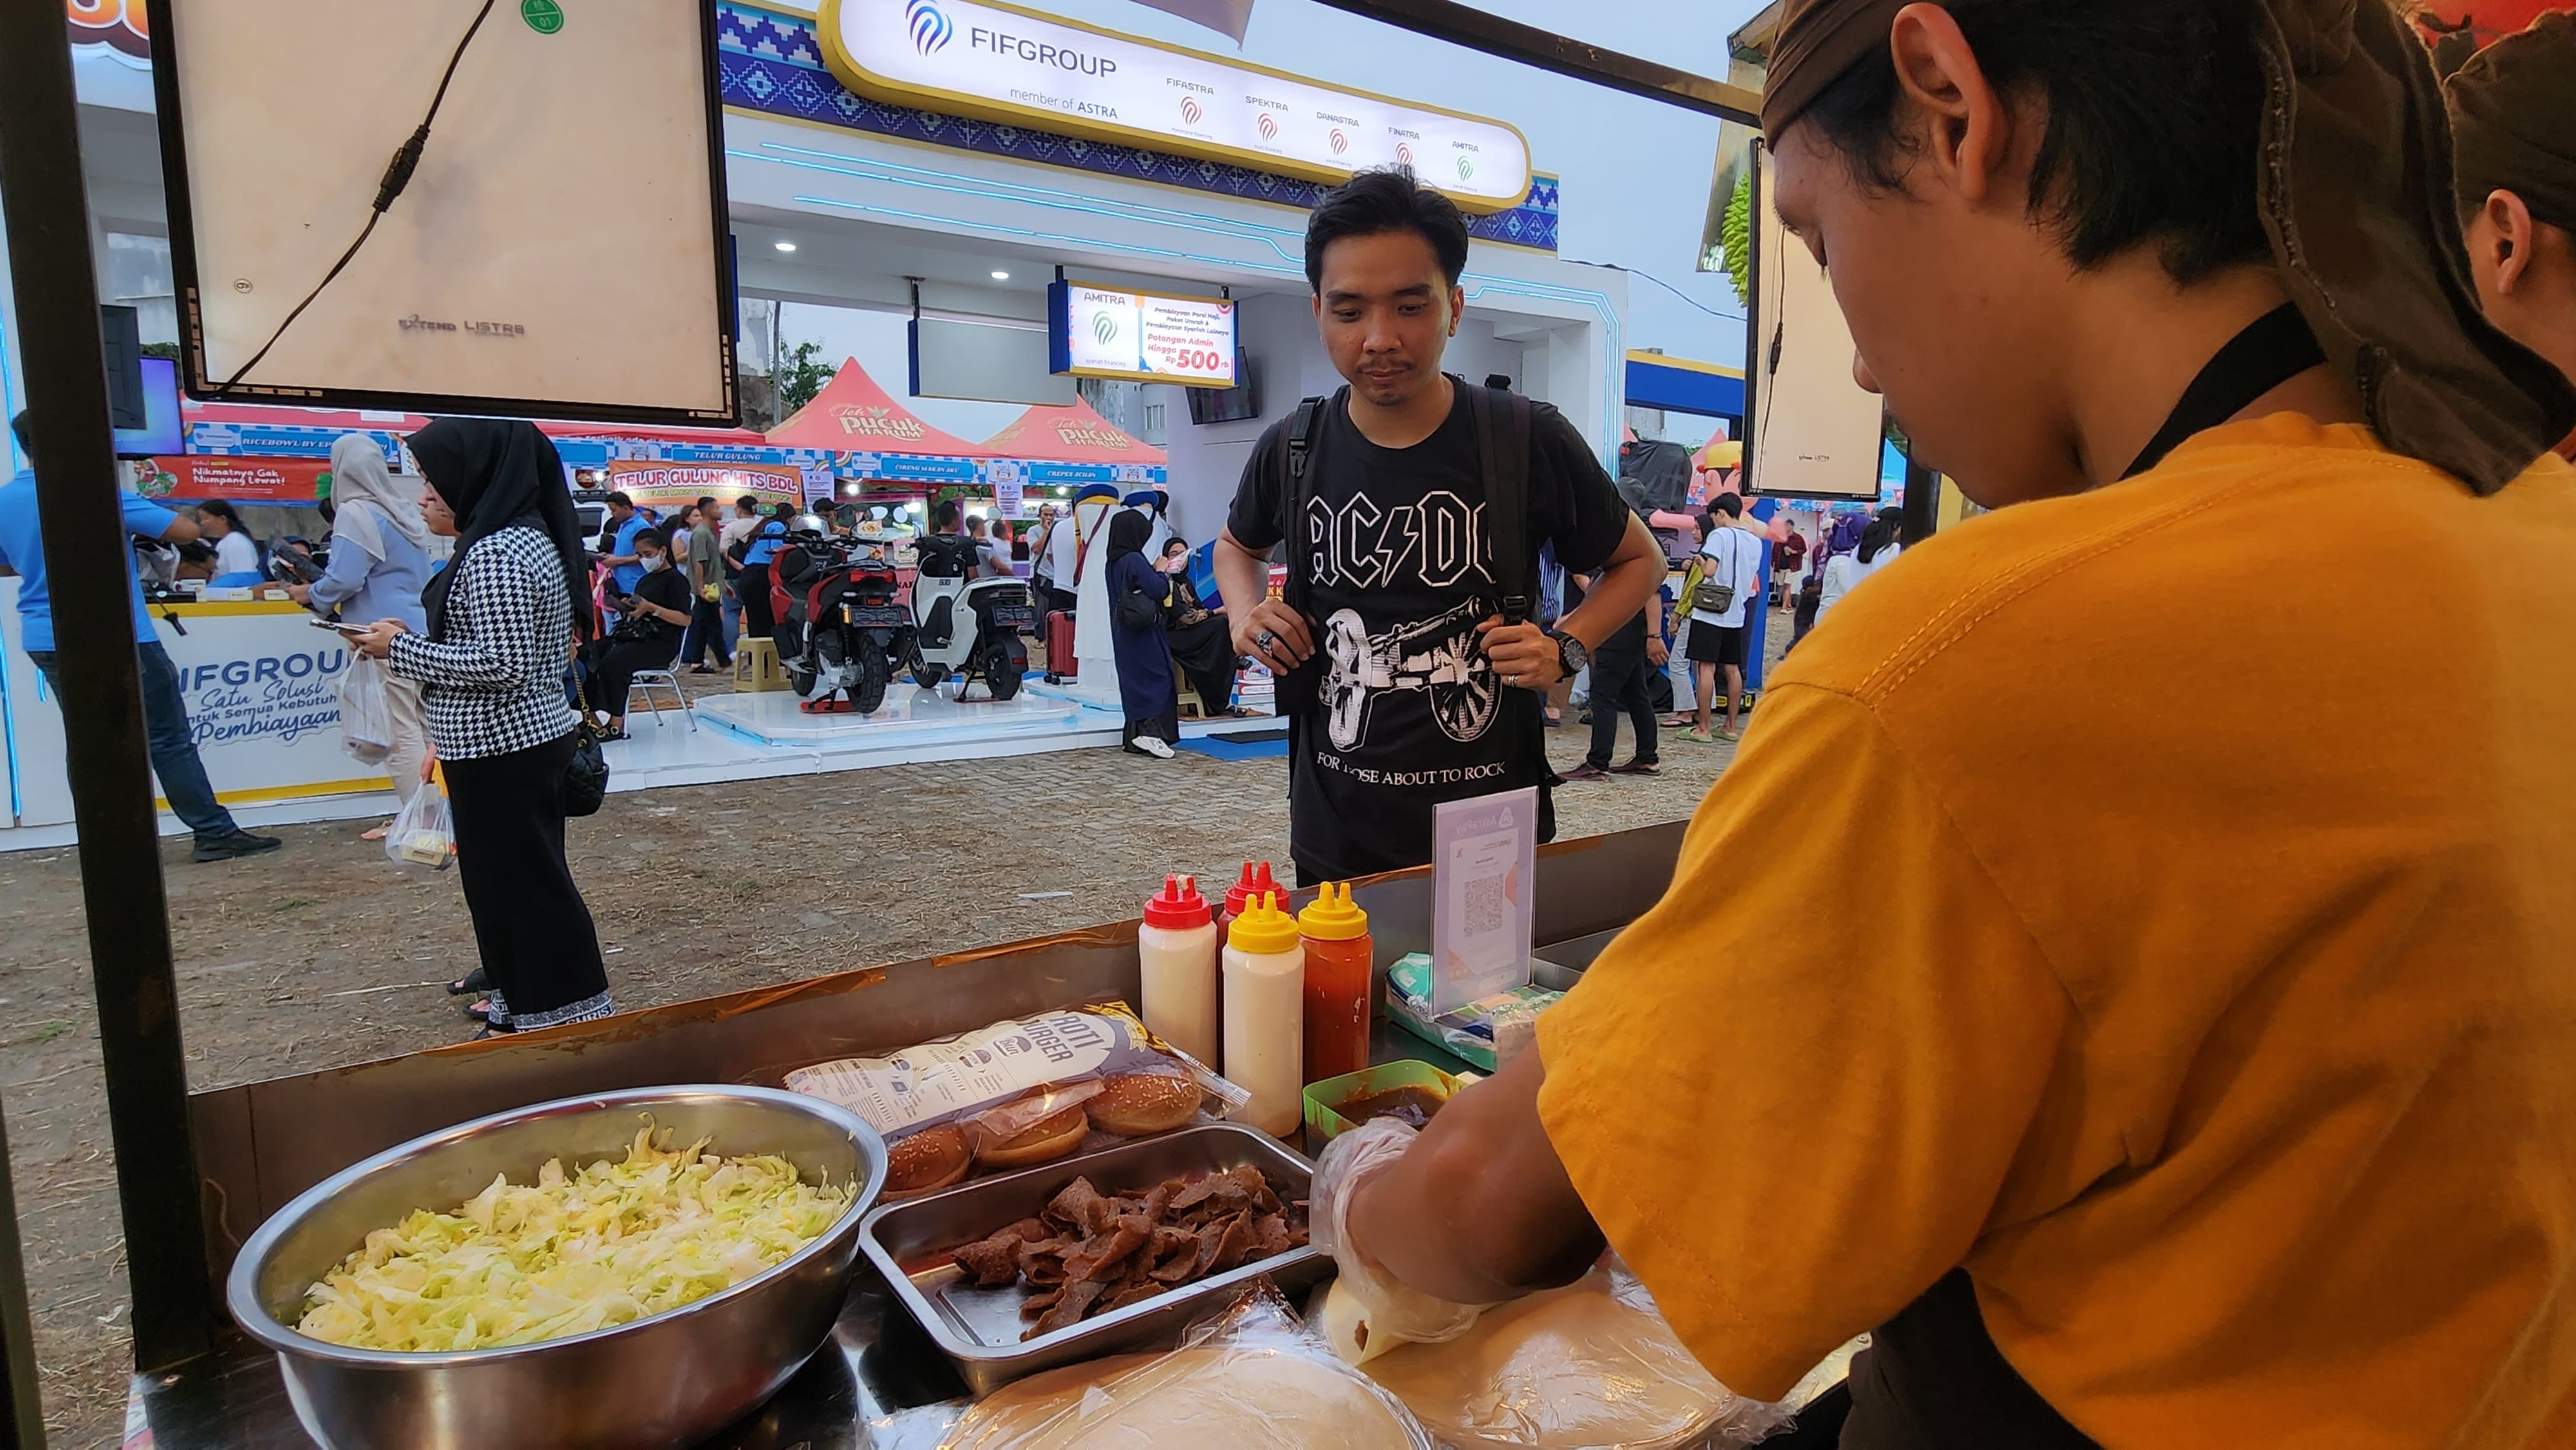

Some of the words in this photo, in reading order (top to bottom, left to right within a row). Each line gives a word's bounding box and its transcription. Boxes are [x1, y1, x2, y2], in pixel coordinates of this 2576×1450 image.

[971, 27, 1117, 79] FIFGROUP
[1166, 77, 1214, 95] FIFASTRA
[1010, 86, 1058, 109] member
[1062, 97, 1074, 109] of
[1077, 101, 1118, 119] ASTRA
[1245, 95, 1289, 111] SPEKTRA
[1316, 111, 1359, 127] DANASTRA
[1388, 127, 1420, 140] FINATRA
[1452, 140, 1479, 153] AMITRA
[1084, 292, 1126, 305] AMITRA
[1155, 307, 1191, 316] Pembiayaan
[1146, 322, 1182, 330] Pembiayaan
[1148, 334, 1186, 344] Potongan
[1188, 338, 1214, 346] Admin
[1148, 344, 1177, 354] Hingga
[1166, 356, 1176, 364] Rp
[1177, 349, 1219, 371] 500
[860, 428, 922, 438] HARUM
[243, 438, 298, 447] RICEBOWL
[301, 440, 317, 448] BY
[193, 468, 253, 482] Nikmatnya
[257, 469, 278, 477] Gak
[193, 475, 245, 486] Numpang
[616, 471, 667, 488] TELUR
[670, 470, 730, 484] GULUNG
[734, 471, 765, 487] HITS
[768, 476, 797, 492] BDL
[180, 648, 351, 692] IFGROU
[201, 685, 252, 711] Satu
[263, 675, 323, 702] Solusi
[186, 711, 220, 724] ntuk
[225, 705, 273, 719] Semua
[279, 694, 337, 709] Kebutuh
[192, 707, 341, 745] Pembiayaan
[1317, 752, 1340, 770] FOR
[1381, 770, 1437, 785] ABOUT
[1439, 768, 1461, 783] TO
[1464, 762, 1506, 780] ROCK
[1049, 1015, 1104, 1050] ROTI
[1023, 1021, 1074, 1063] URGER
